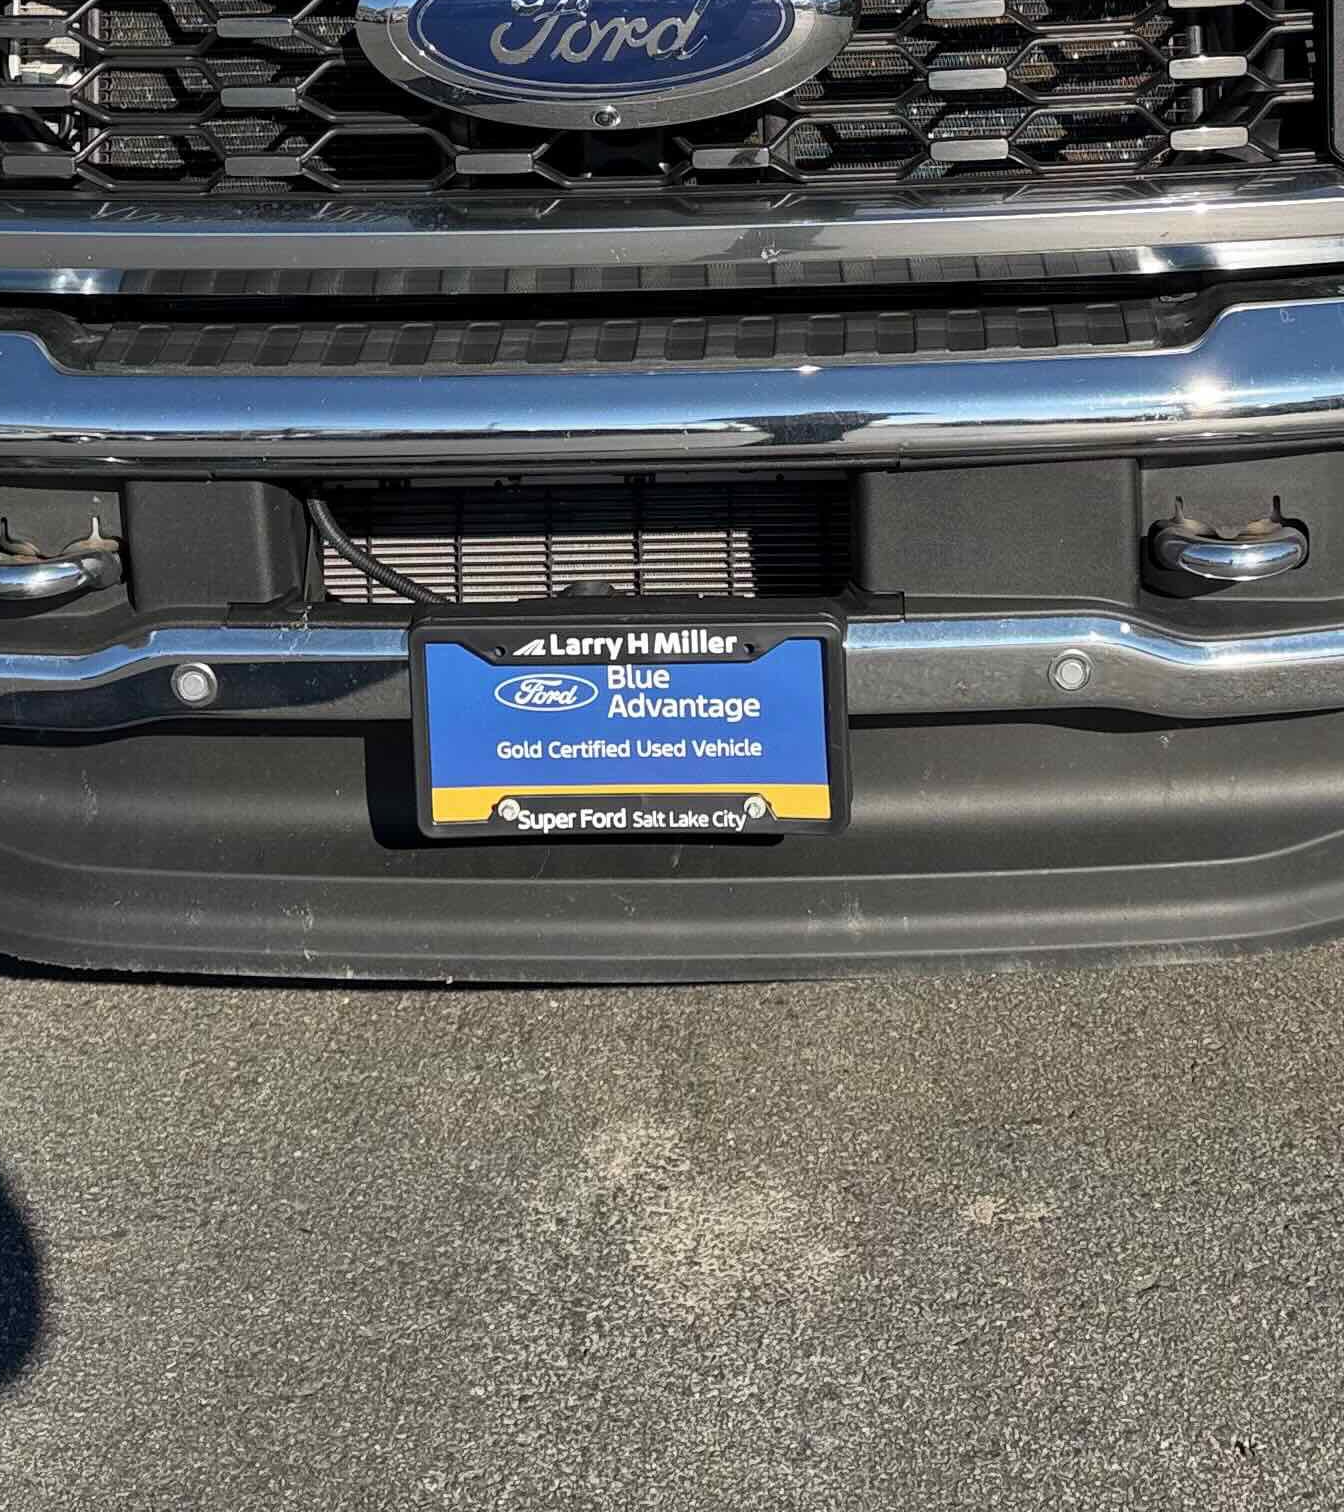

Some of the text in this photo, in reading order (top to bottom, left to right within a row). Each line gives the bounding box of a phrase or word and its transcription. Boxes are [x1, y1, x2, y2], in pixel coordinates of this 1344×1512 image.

[549, 629, 738, 660] Larry H Miller
[607, 664, 671, 689] Blue
[514, 679, 578, 705] Ford
[607, 693, 761, 722] Advantage
[496, 739, 763, 759] Gold Certified Used Vehicle
[517, 808, 747, 834] Super Ford Salt Lake City
